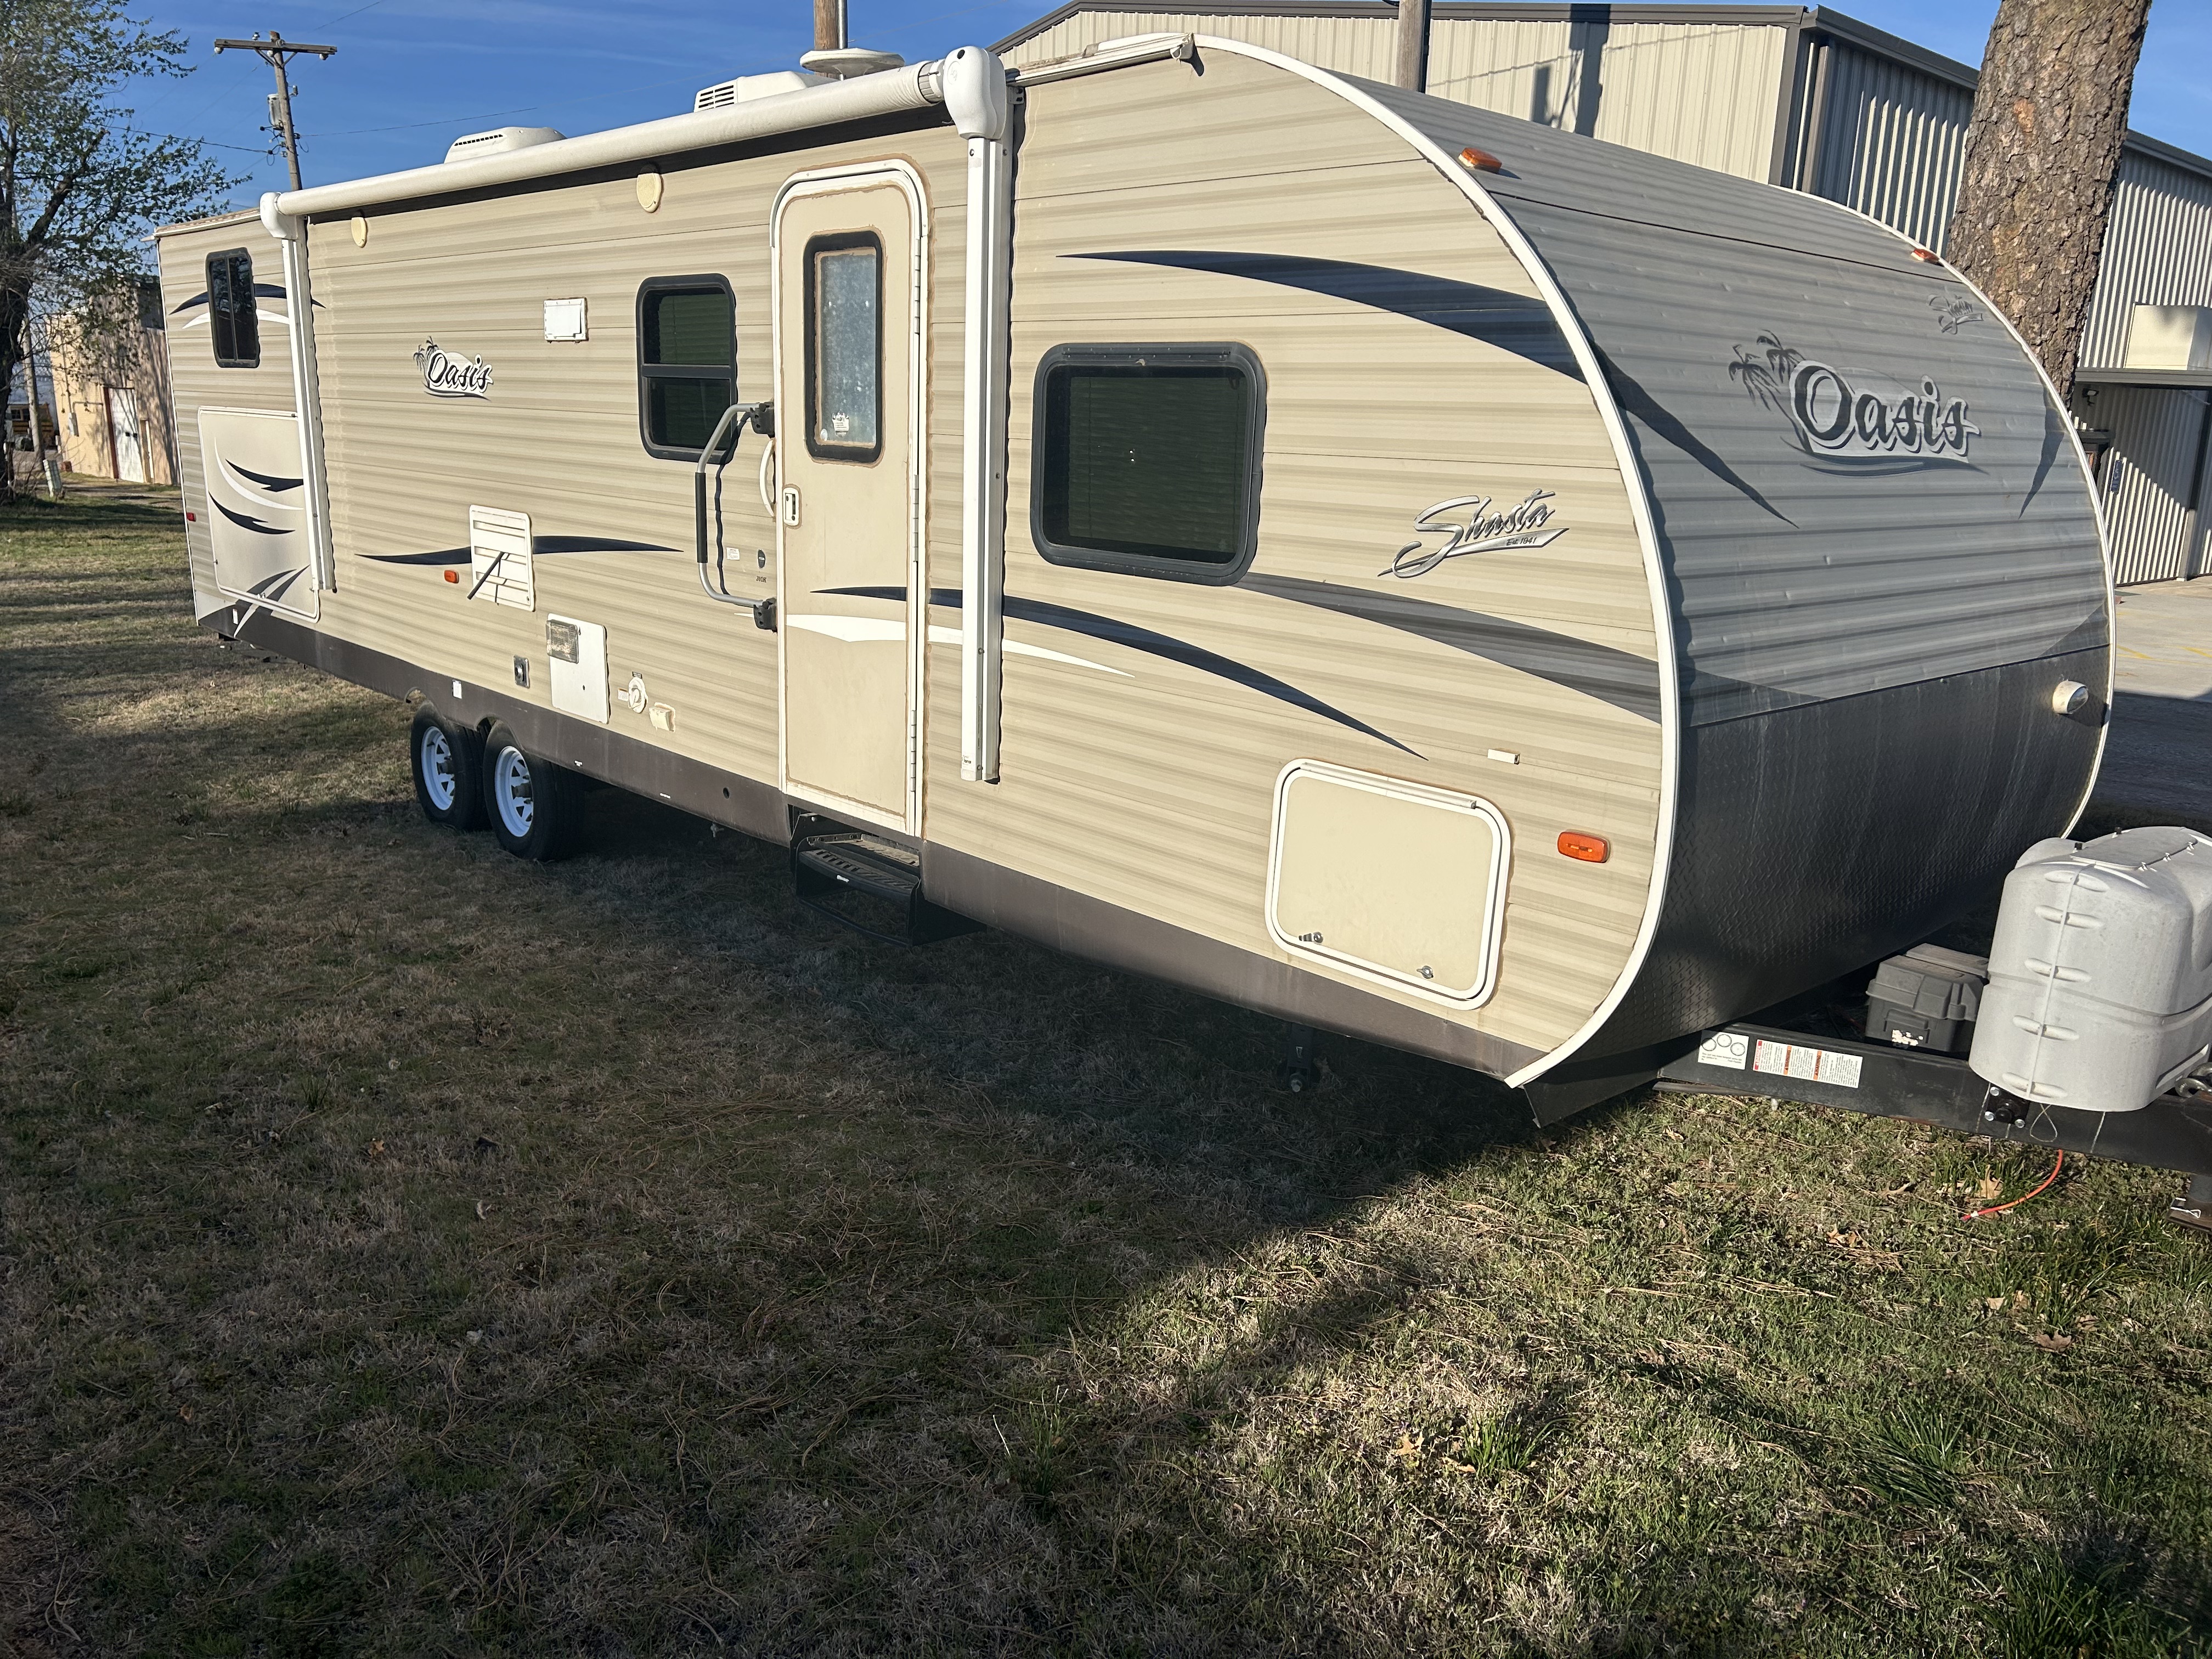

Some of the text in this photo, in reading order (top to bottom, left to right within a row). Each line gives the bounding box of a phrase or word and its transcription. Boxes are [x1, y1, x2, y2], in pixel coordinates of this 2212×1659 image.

[427, 352, 493, 391] Oasis
[1790, 363, 1981, 456] Oasis
[1392, 488, 1555, 578] Shasta
